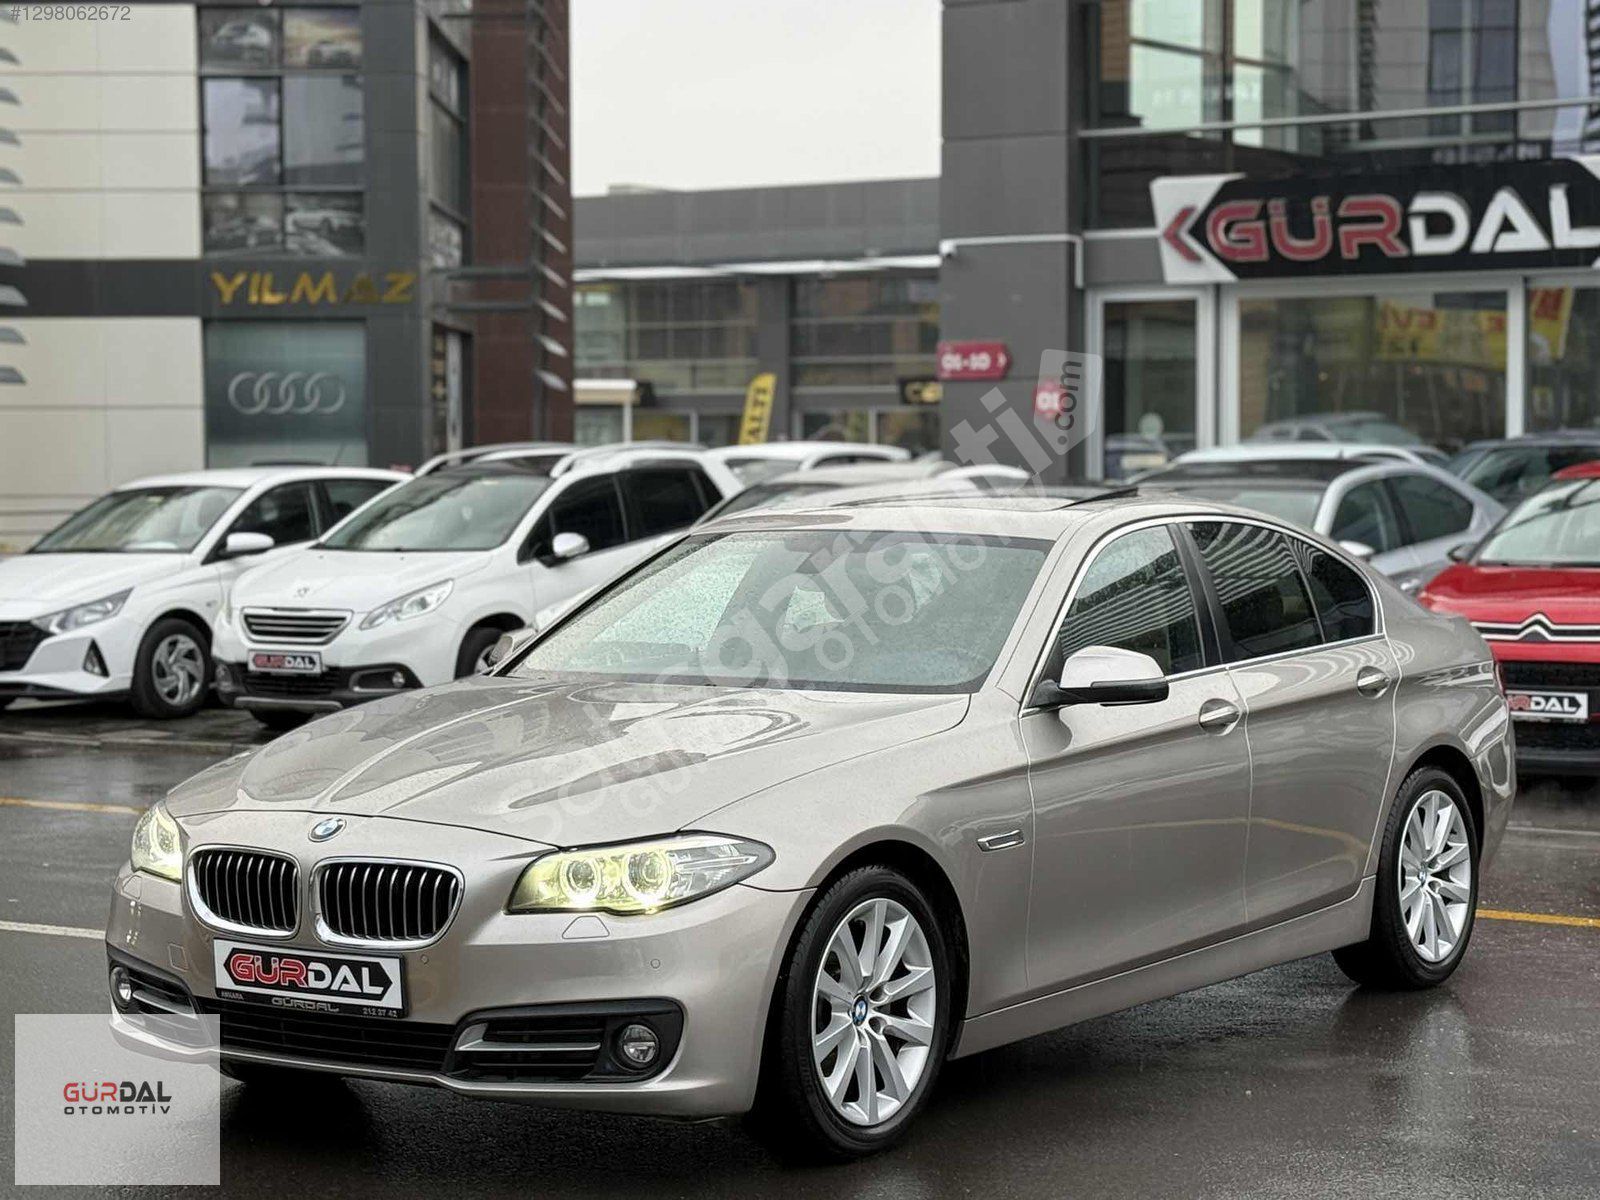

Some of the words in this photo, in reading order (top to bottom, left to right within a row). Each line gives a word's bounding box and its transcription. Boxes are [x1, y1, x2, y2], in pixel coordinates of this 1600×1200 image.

[1205, 182, 1600, 262] GÜRDAL
[211, 271, 416, 304] YILMAZ
[1507, 695, 1578, 712] RDAL
[230, 953, 385, 995] GÜRDAL
